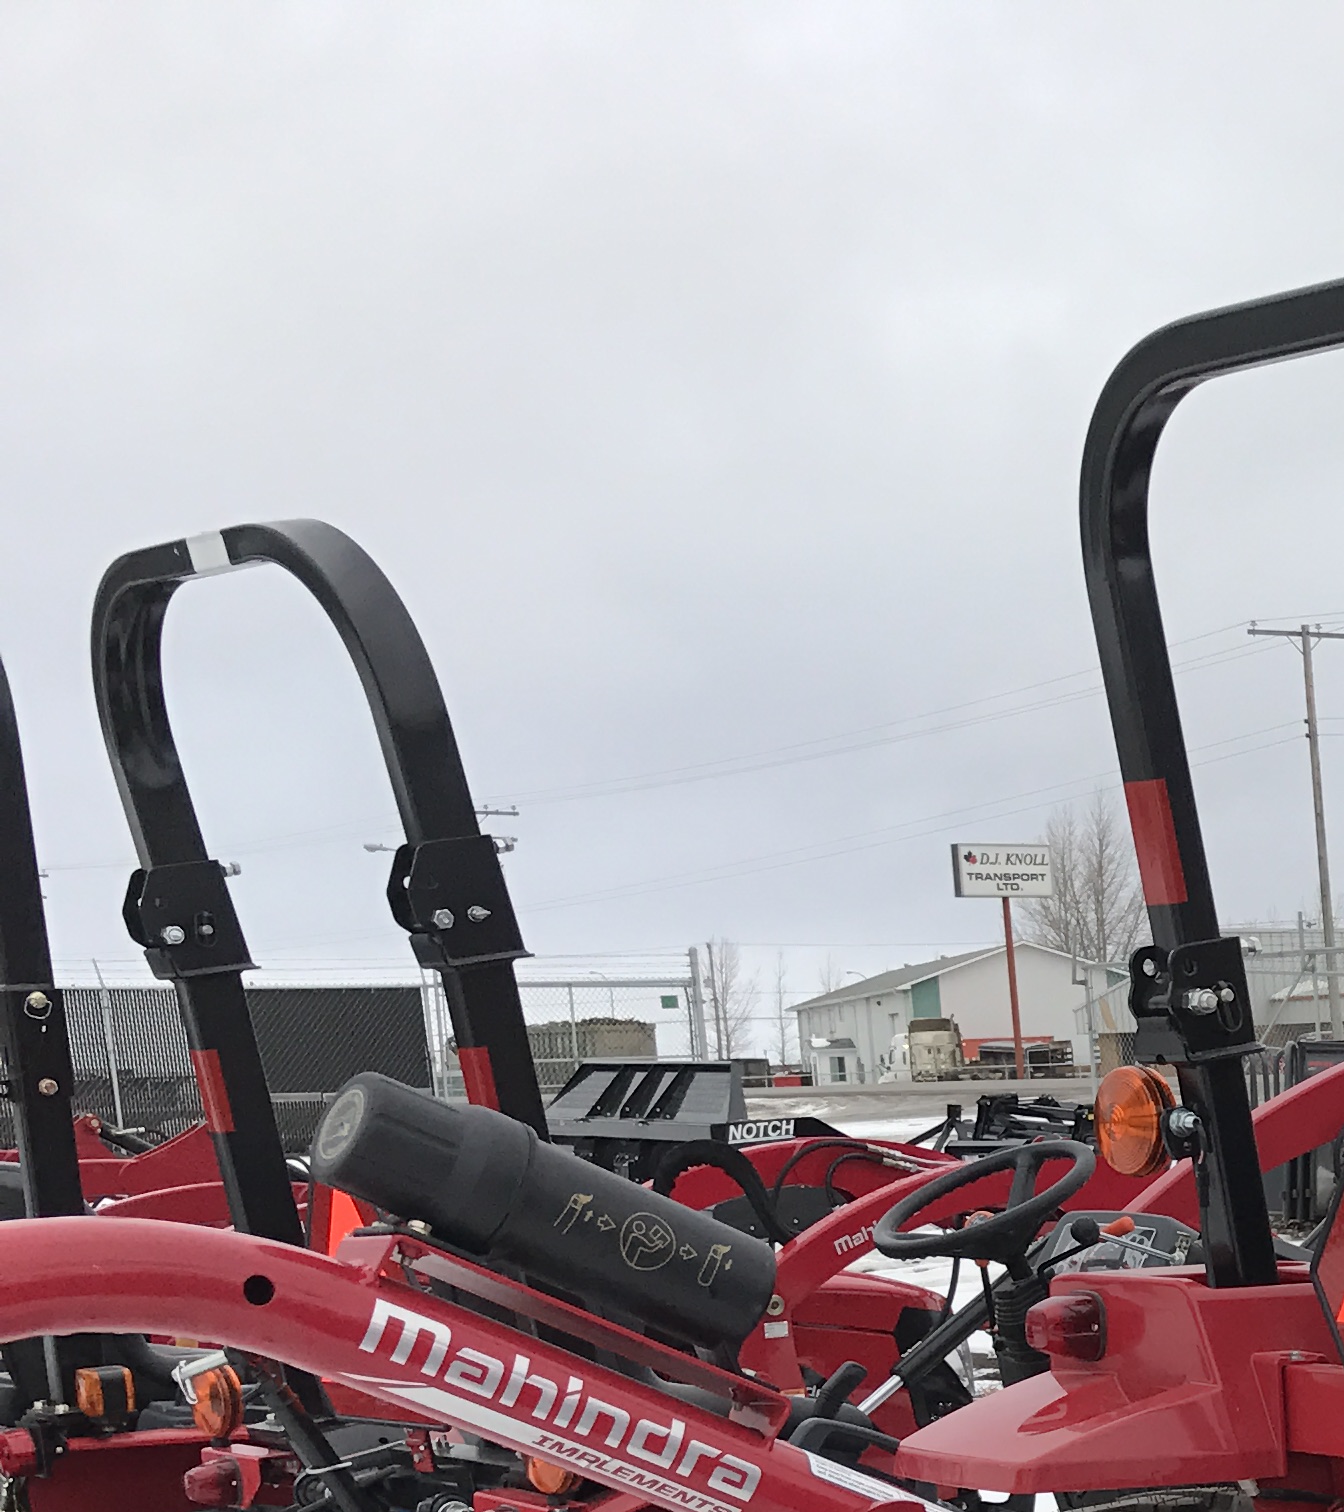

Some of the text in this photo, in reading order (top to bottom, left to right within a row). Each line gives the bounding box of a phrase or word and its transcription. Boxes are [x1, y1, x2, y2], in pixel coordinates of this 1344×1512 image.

[980, 852, 1049, 866] D.J. KNOLL
[966, 872, 1047, 882] TRANSPORT
[996, 882, 1024, 892] LTD.
[728, 1119, 795, 1141] NOTCH
[358, 1297, 762, 1502] Mahindra
